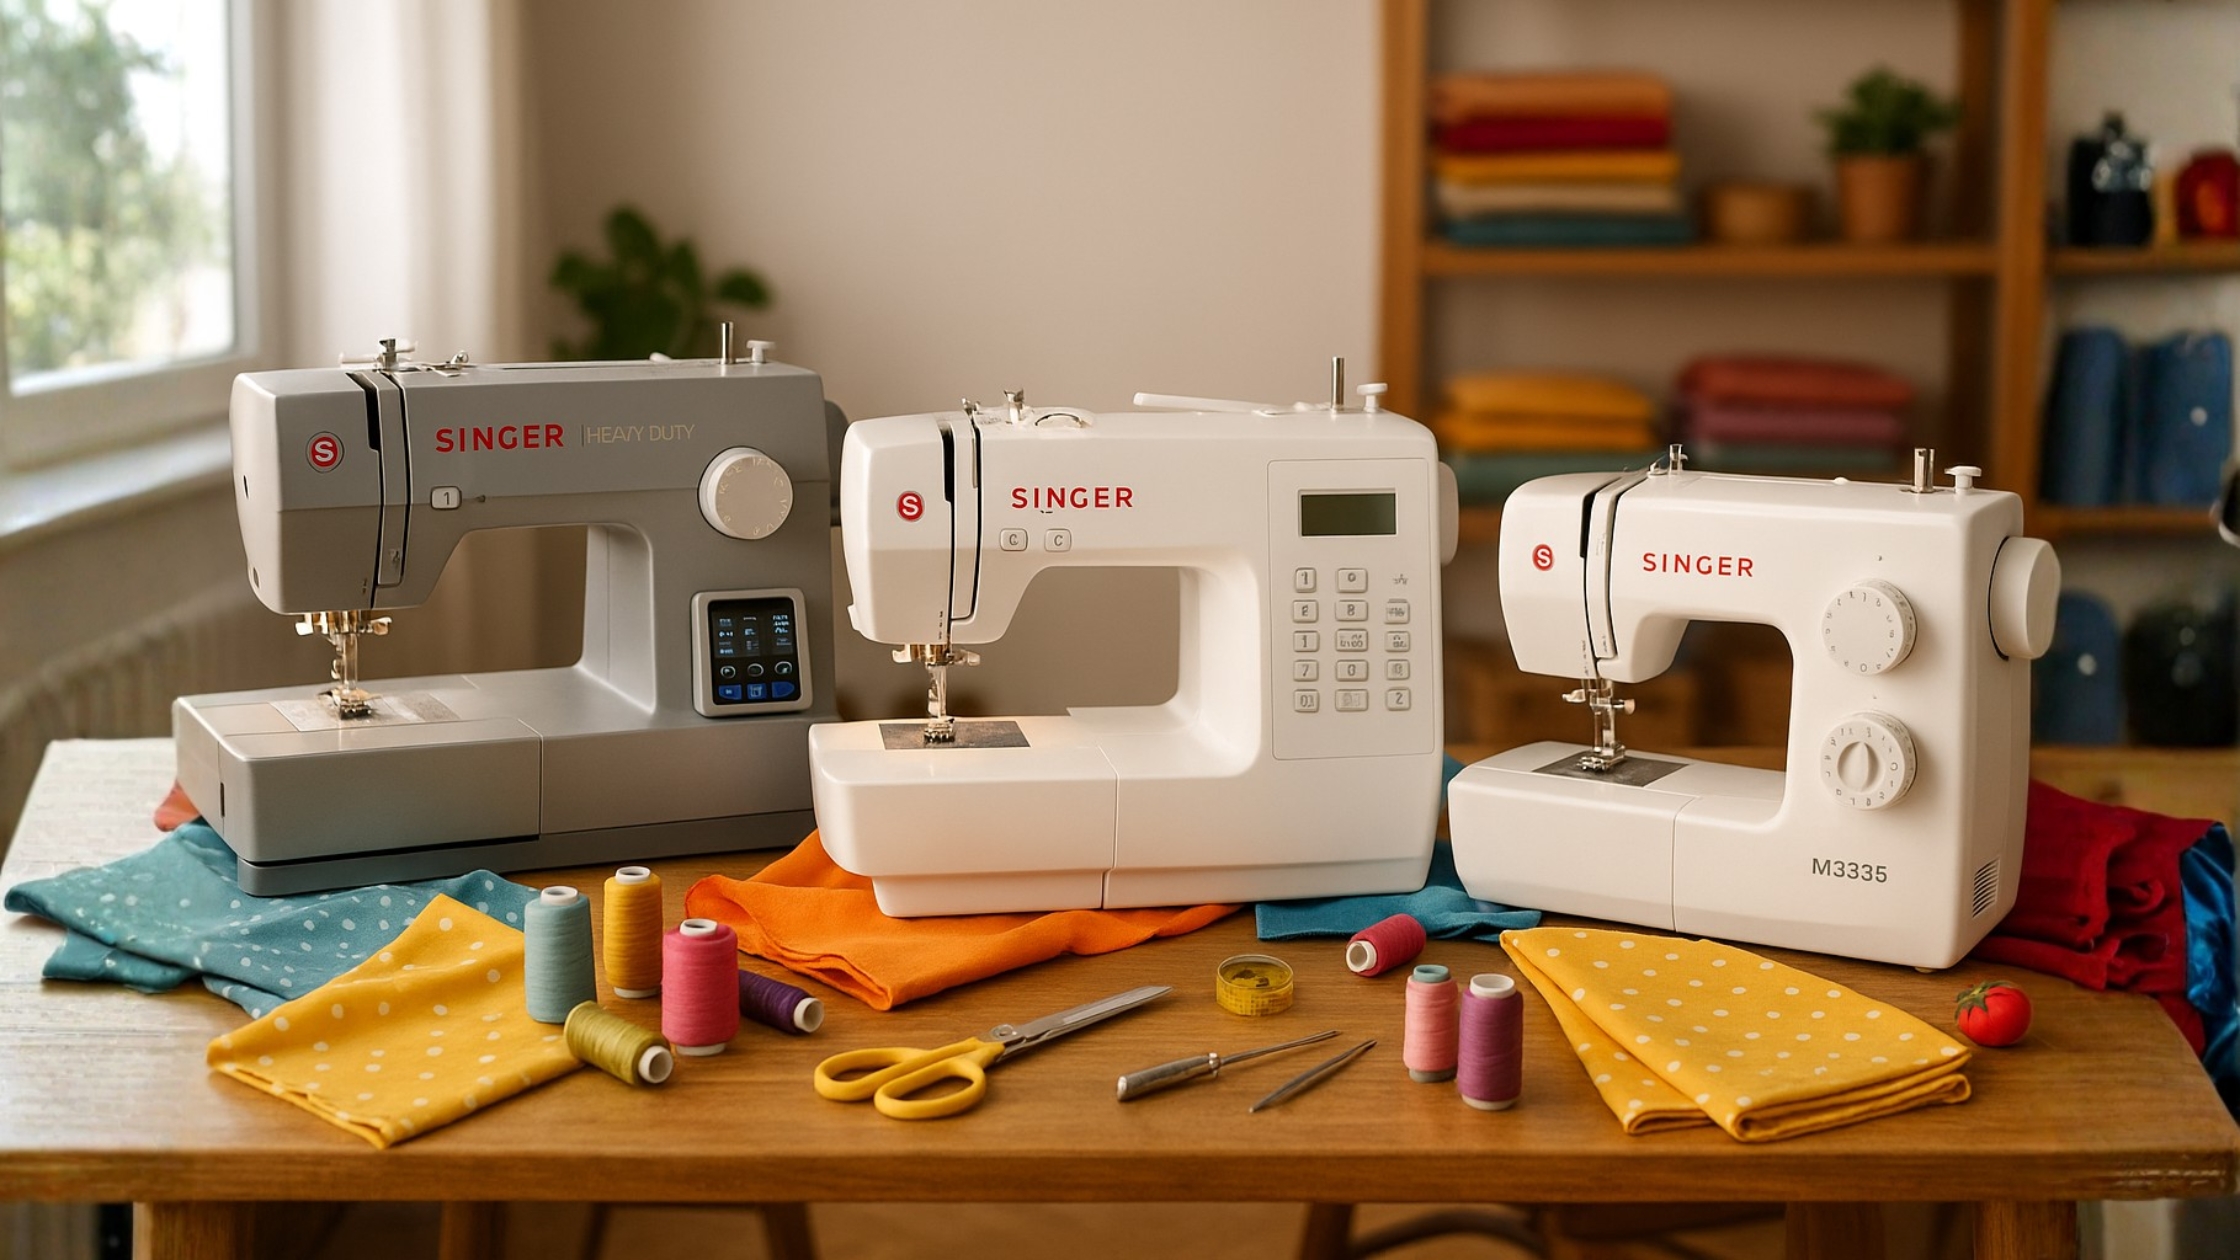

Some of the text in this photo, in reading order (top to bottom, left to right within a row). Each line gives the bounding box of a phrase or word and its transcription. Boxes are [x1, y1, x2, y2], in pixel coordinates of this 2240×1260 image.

[435, 423, 564, 453] SINGER
[649, 423, 696, 443] DUTY
[314, 440, 335, 463] S
[902, 495, 919, 517] S
[1011, 487, 1134, 509] SINGER
[1536, 547, 1551, 568] S
[1642, 552, 1755, 578] SINGER
[1812, 857, 1888, 883] M3335
